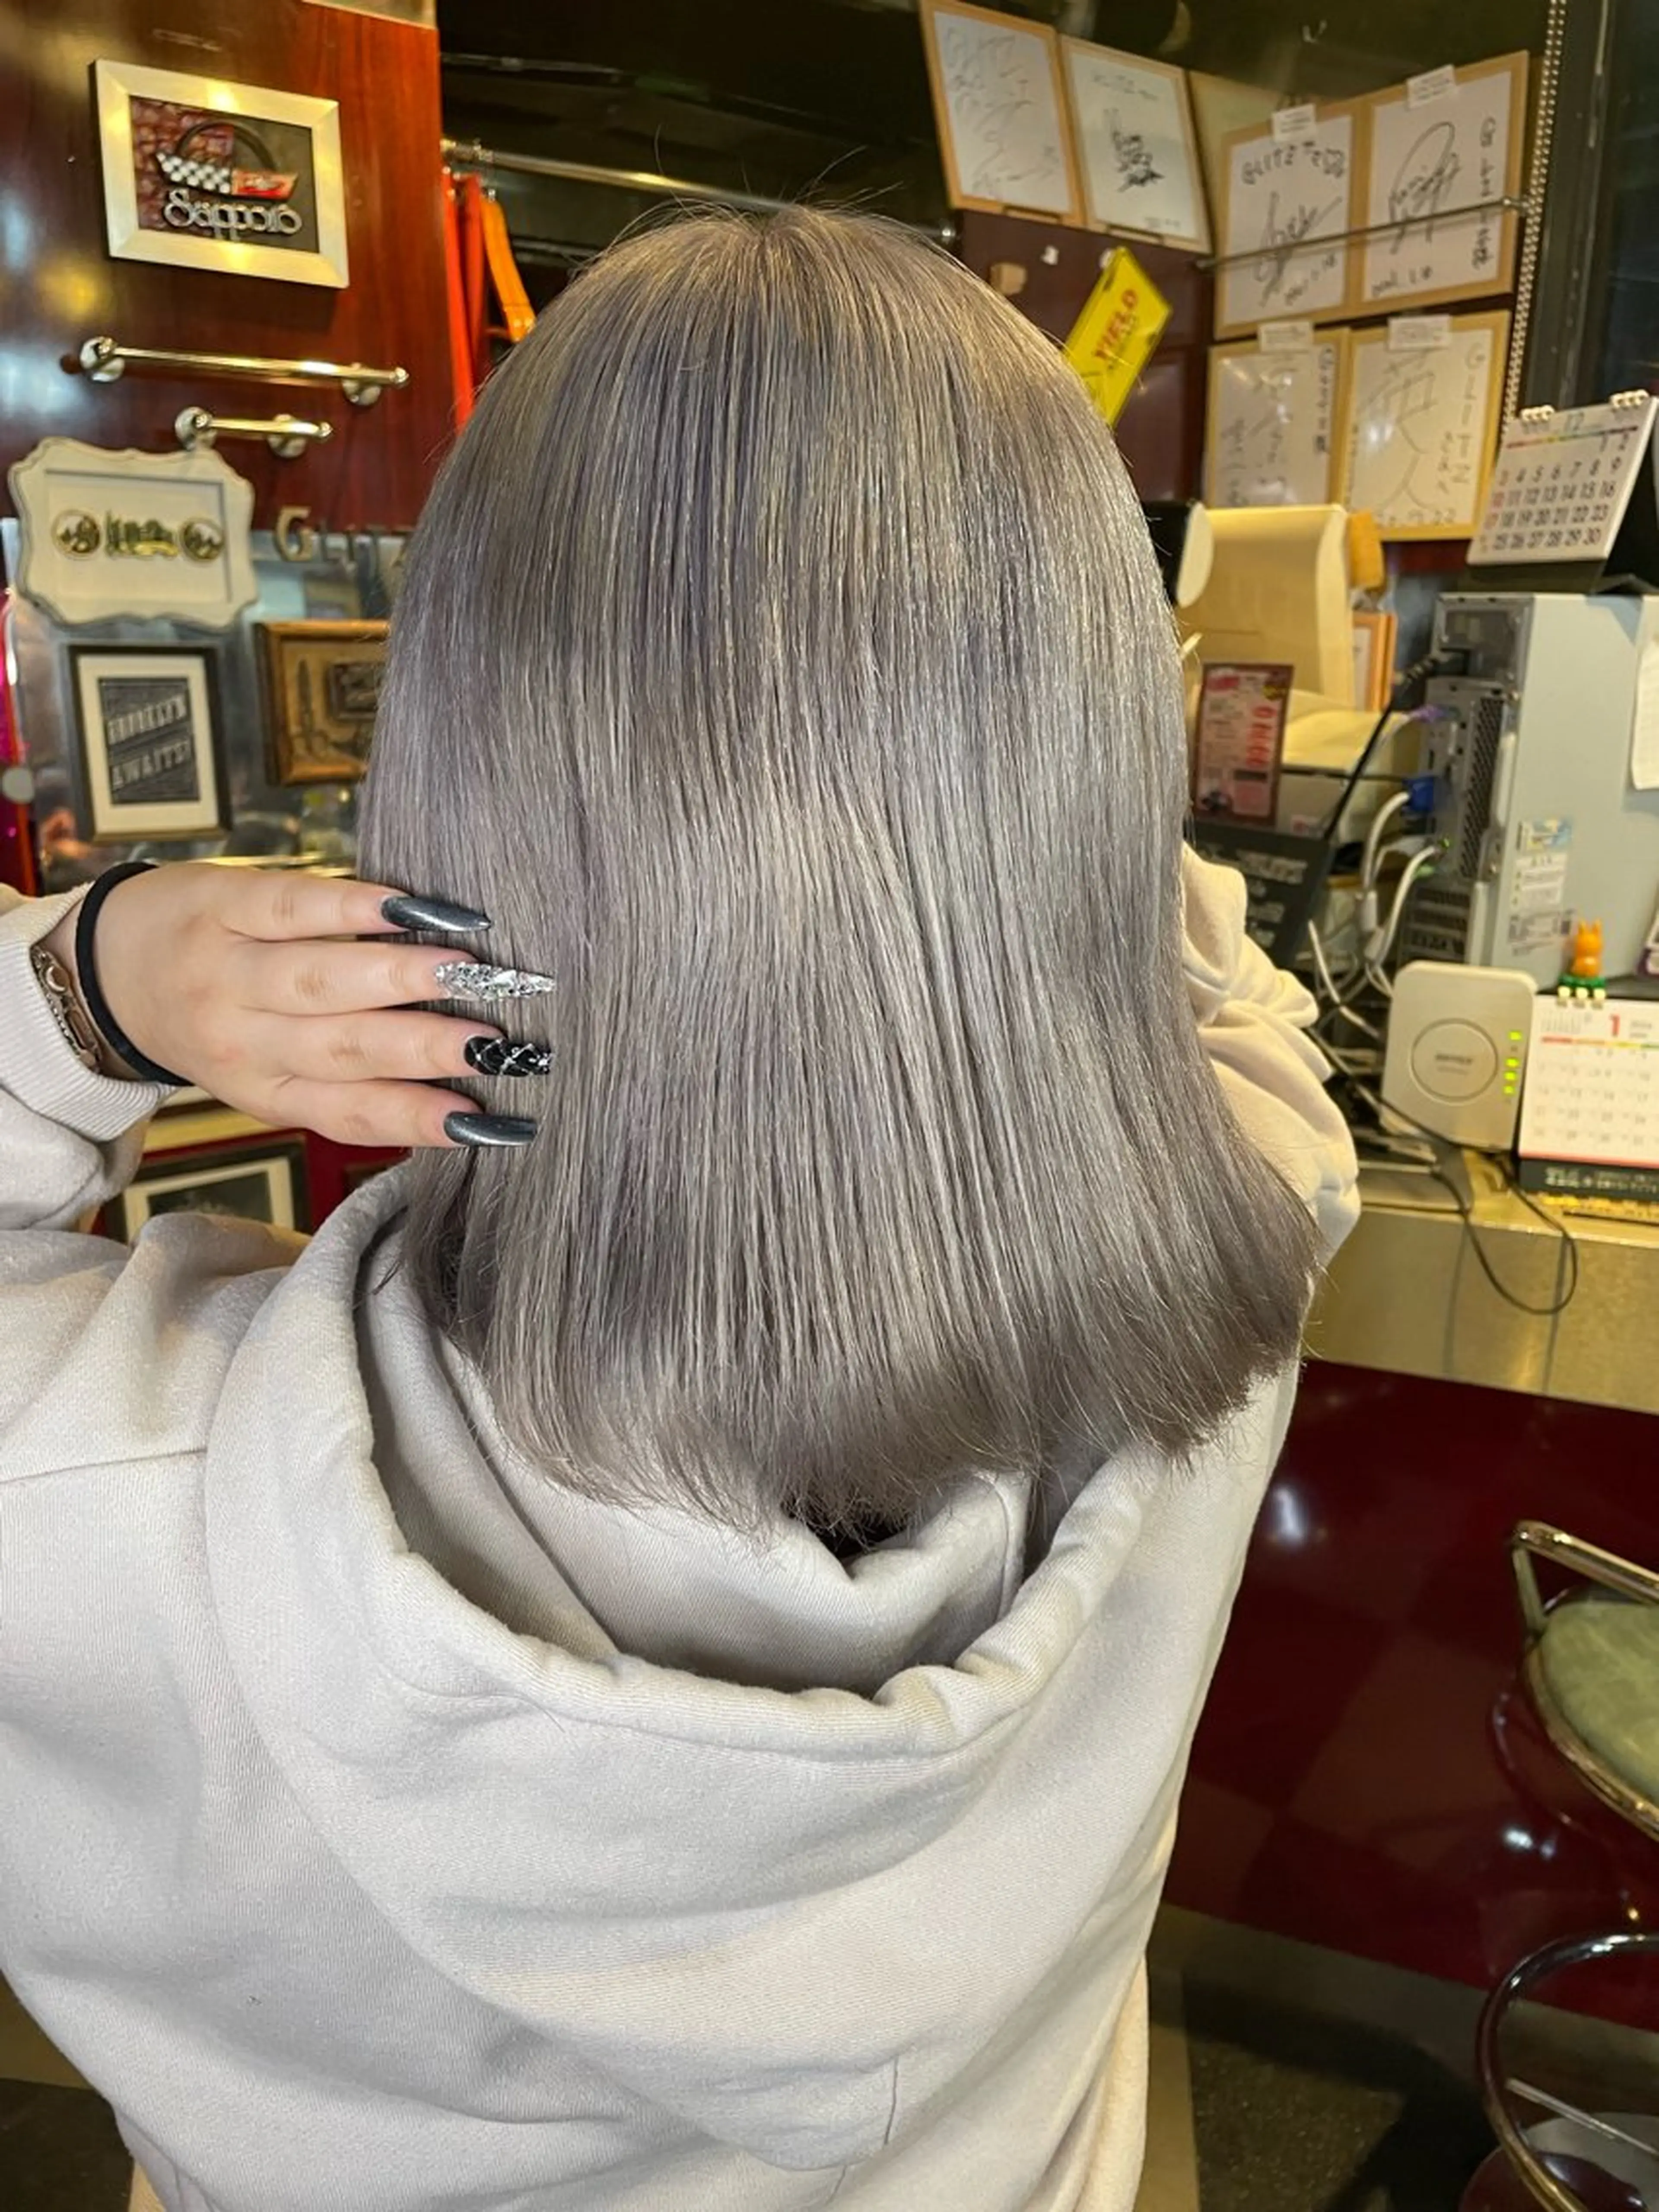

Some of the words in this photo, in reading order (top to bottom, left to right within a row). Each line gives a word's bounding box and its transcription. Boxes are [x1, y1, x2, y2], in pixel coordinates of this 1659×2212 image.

[164, 188, 302, 241] Sapporo
[1569, 460, 1583, 478] 7
[1560, 483, 1578, 501] 14
[1580, 480, 1596, 499] 15
[1599, 479, 1617, 498] 16
[1608, 1013, 1620, 1039] 1
